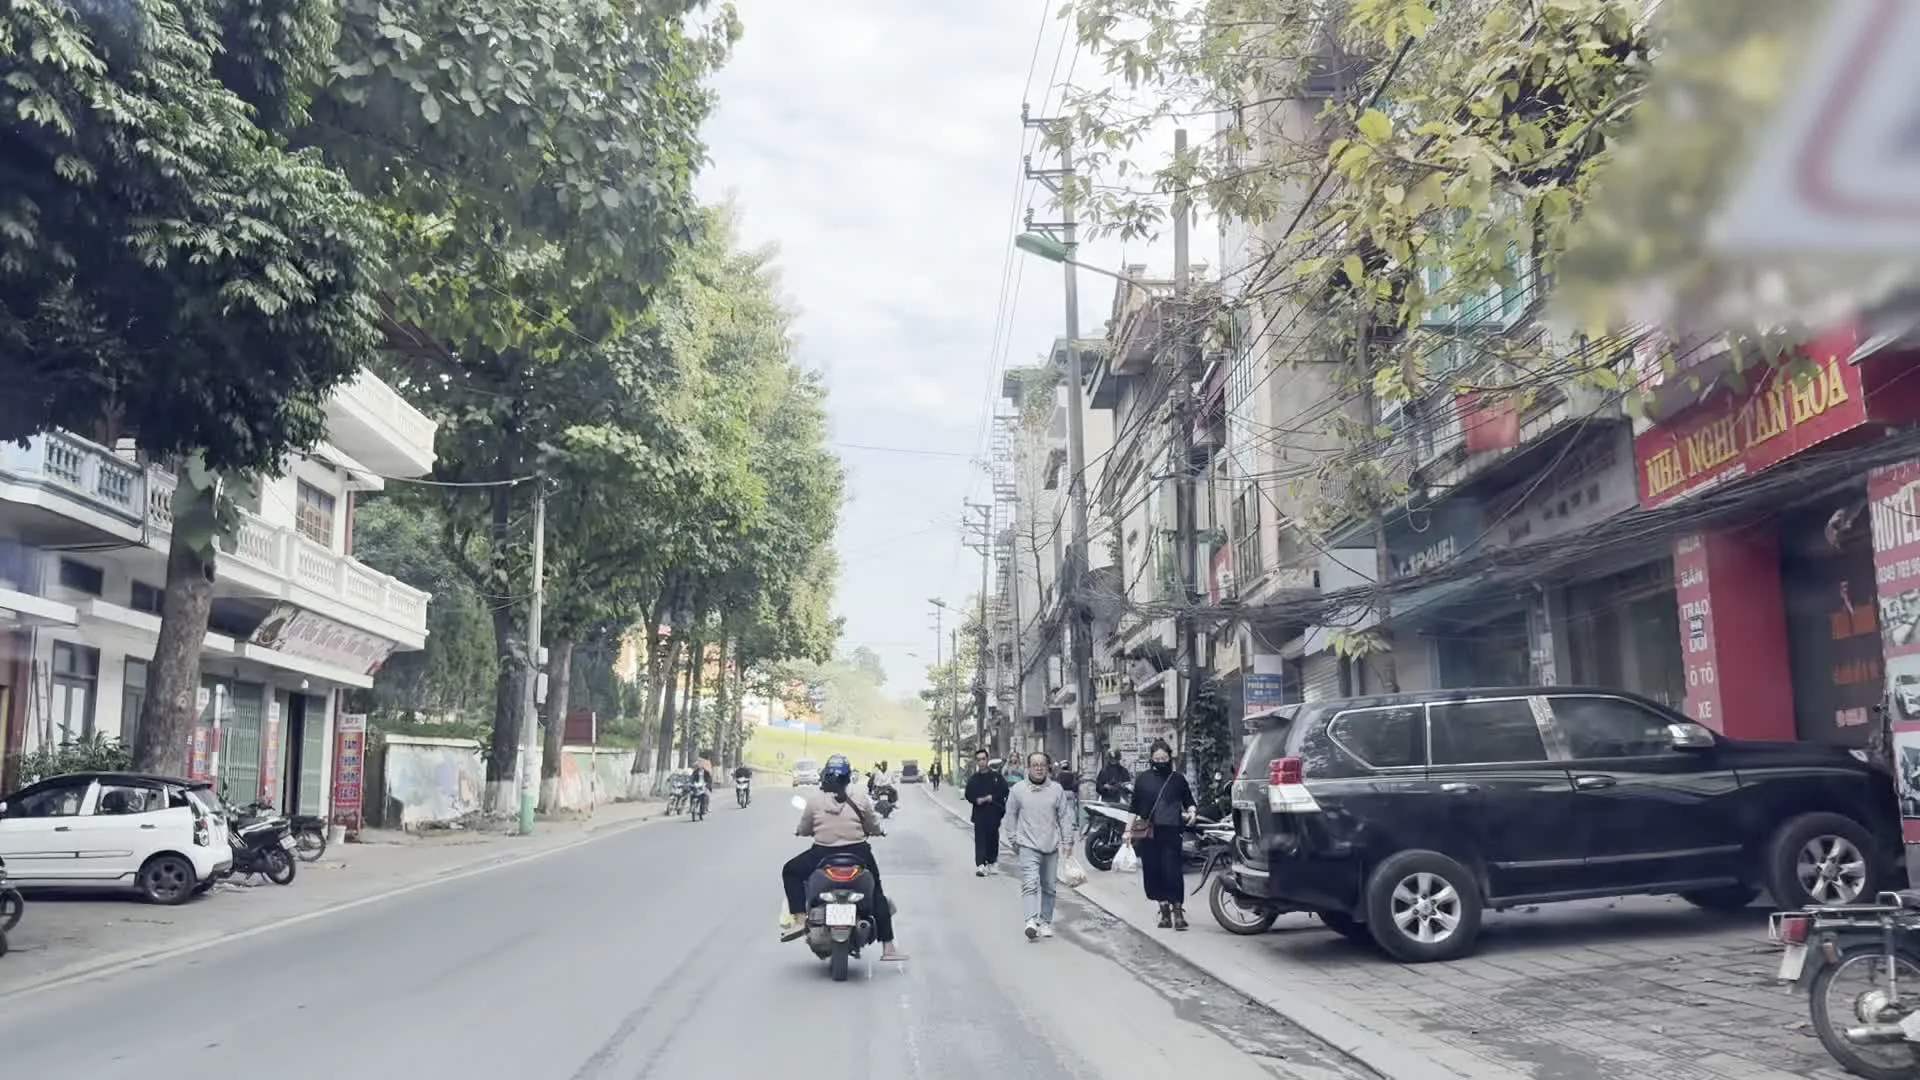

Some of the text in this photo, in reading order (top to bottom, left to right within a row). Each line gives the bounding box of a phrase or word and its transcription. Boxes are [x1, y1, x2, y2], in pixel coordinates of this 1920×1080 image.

[1647, 430, 1685, 496] NHÀ
[1690, 661, 1714, 687] Ô TÔ
[1698, 701, 1713, 719] XE
